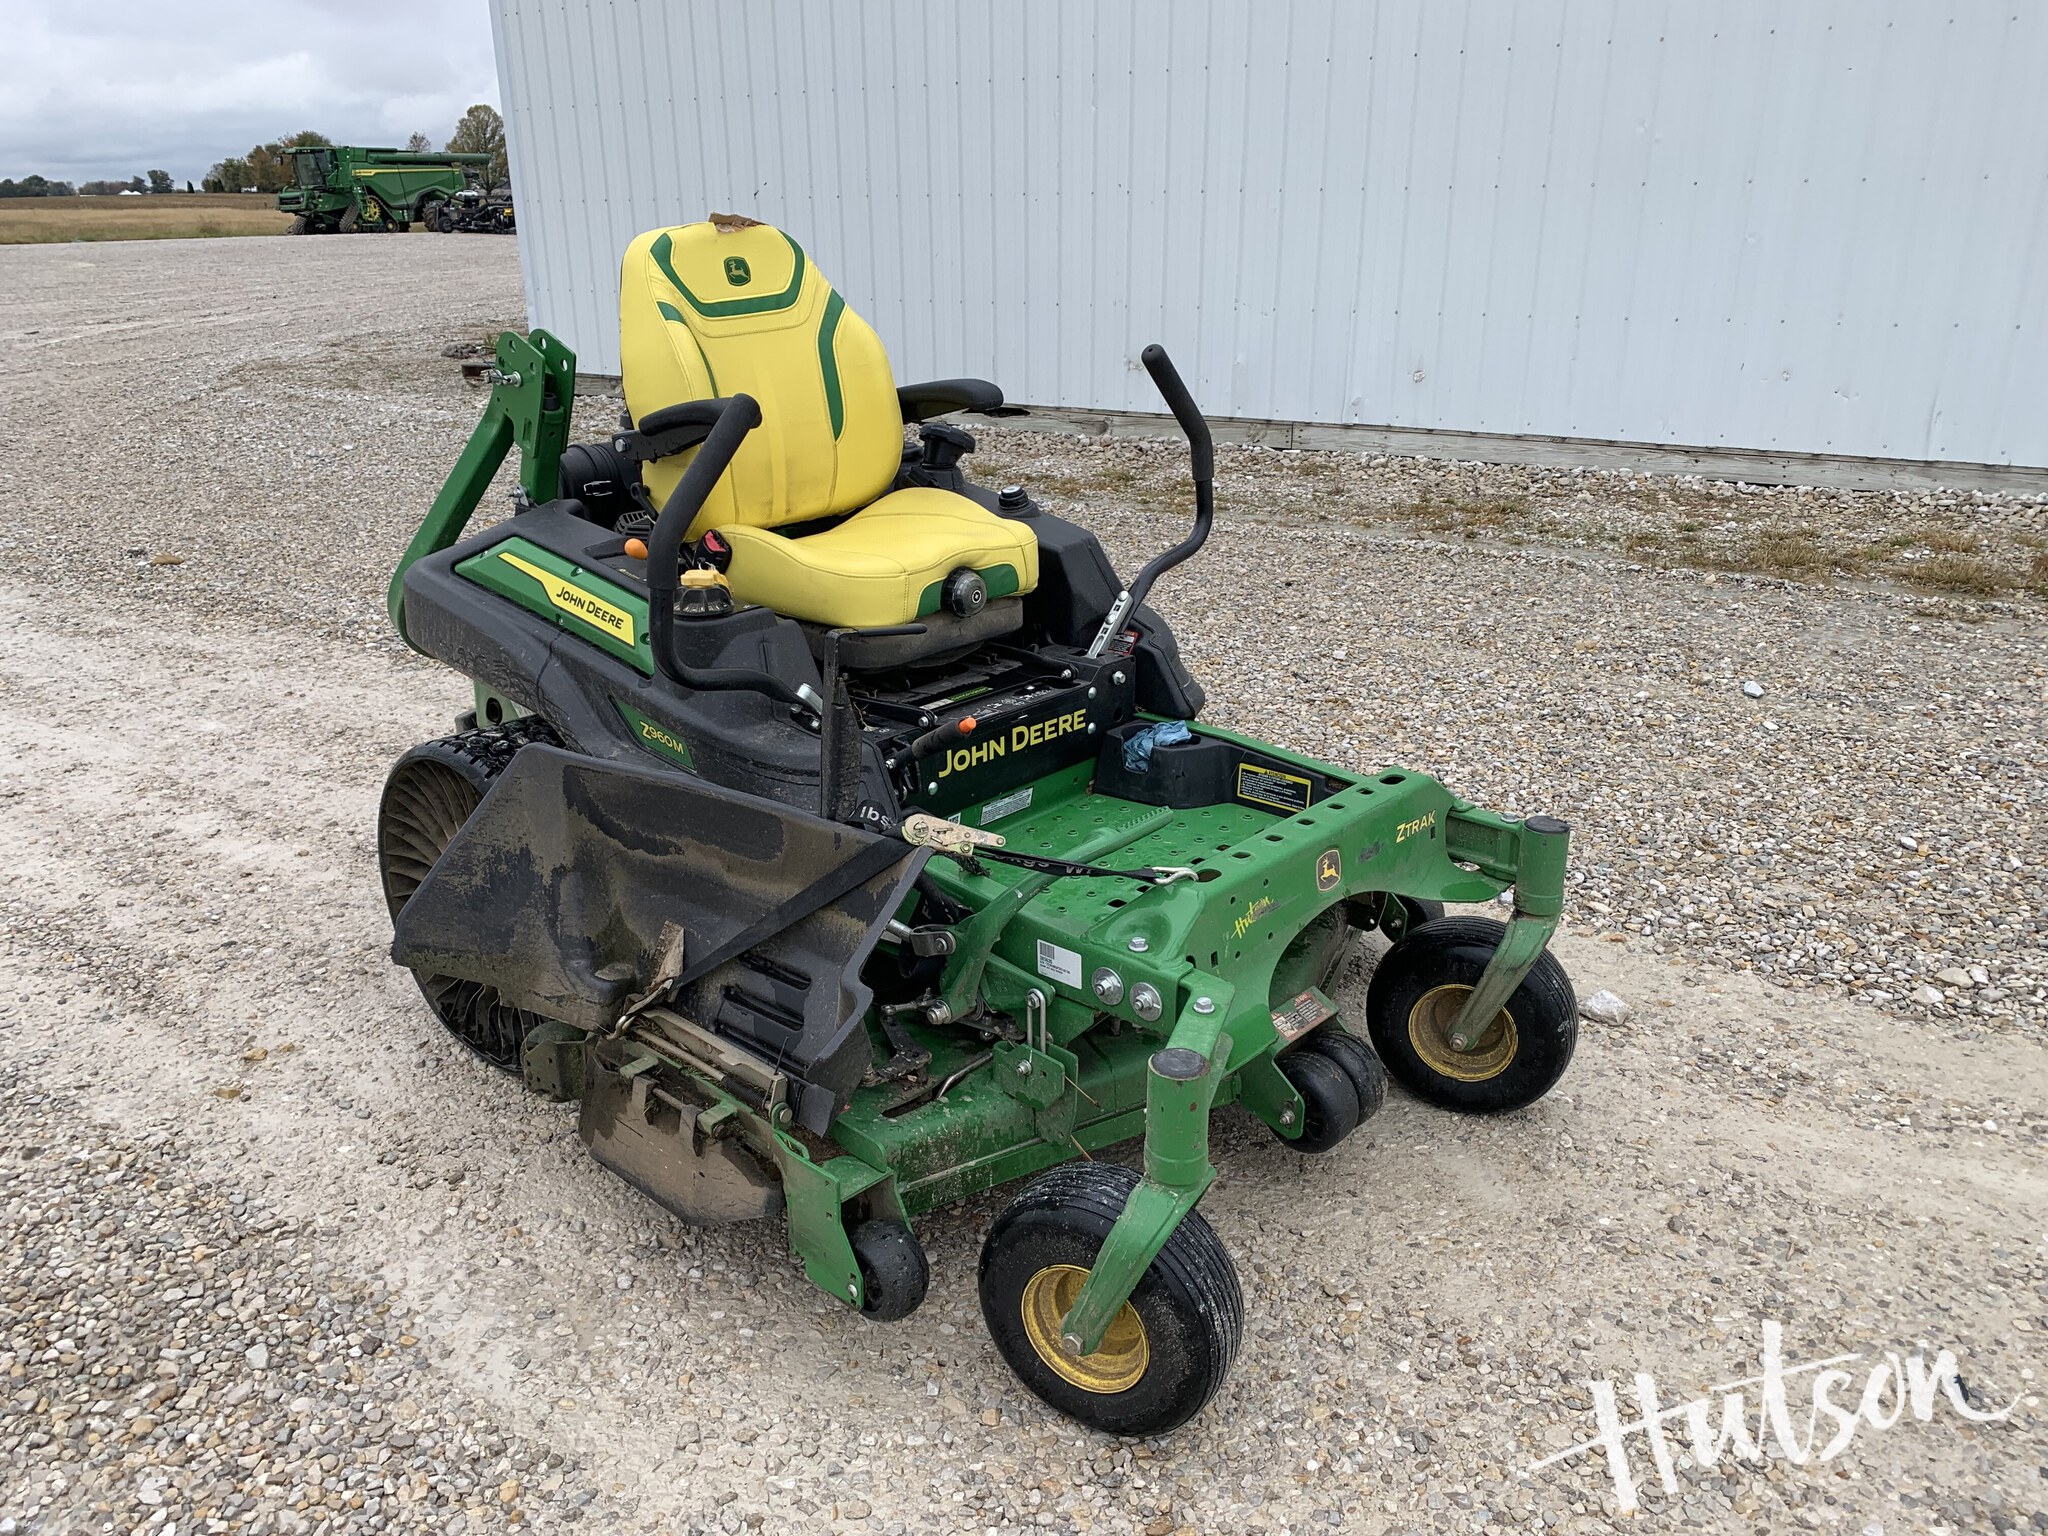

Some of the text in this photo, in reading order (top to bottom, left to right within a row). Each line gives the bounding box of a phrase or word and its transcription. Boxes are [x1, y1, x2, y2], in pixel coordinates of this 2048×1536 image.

[556, 587, 624, 630] JOHN DEERE
[640, 720, 684, 755] Z960M
[938, 708, 1087, 778] JOHN DEERE
[1396, 810, 1436, 844] ZTRAK
[1231, 896, 1275, 939] Hutn
